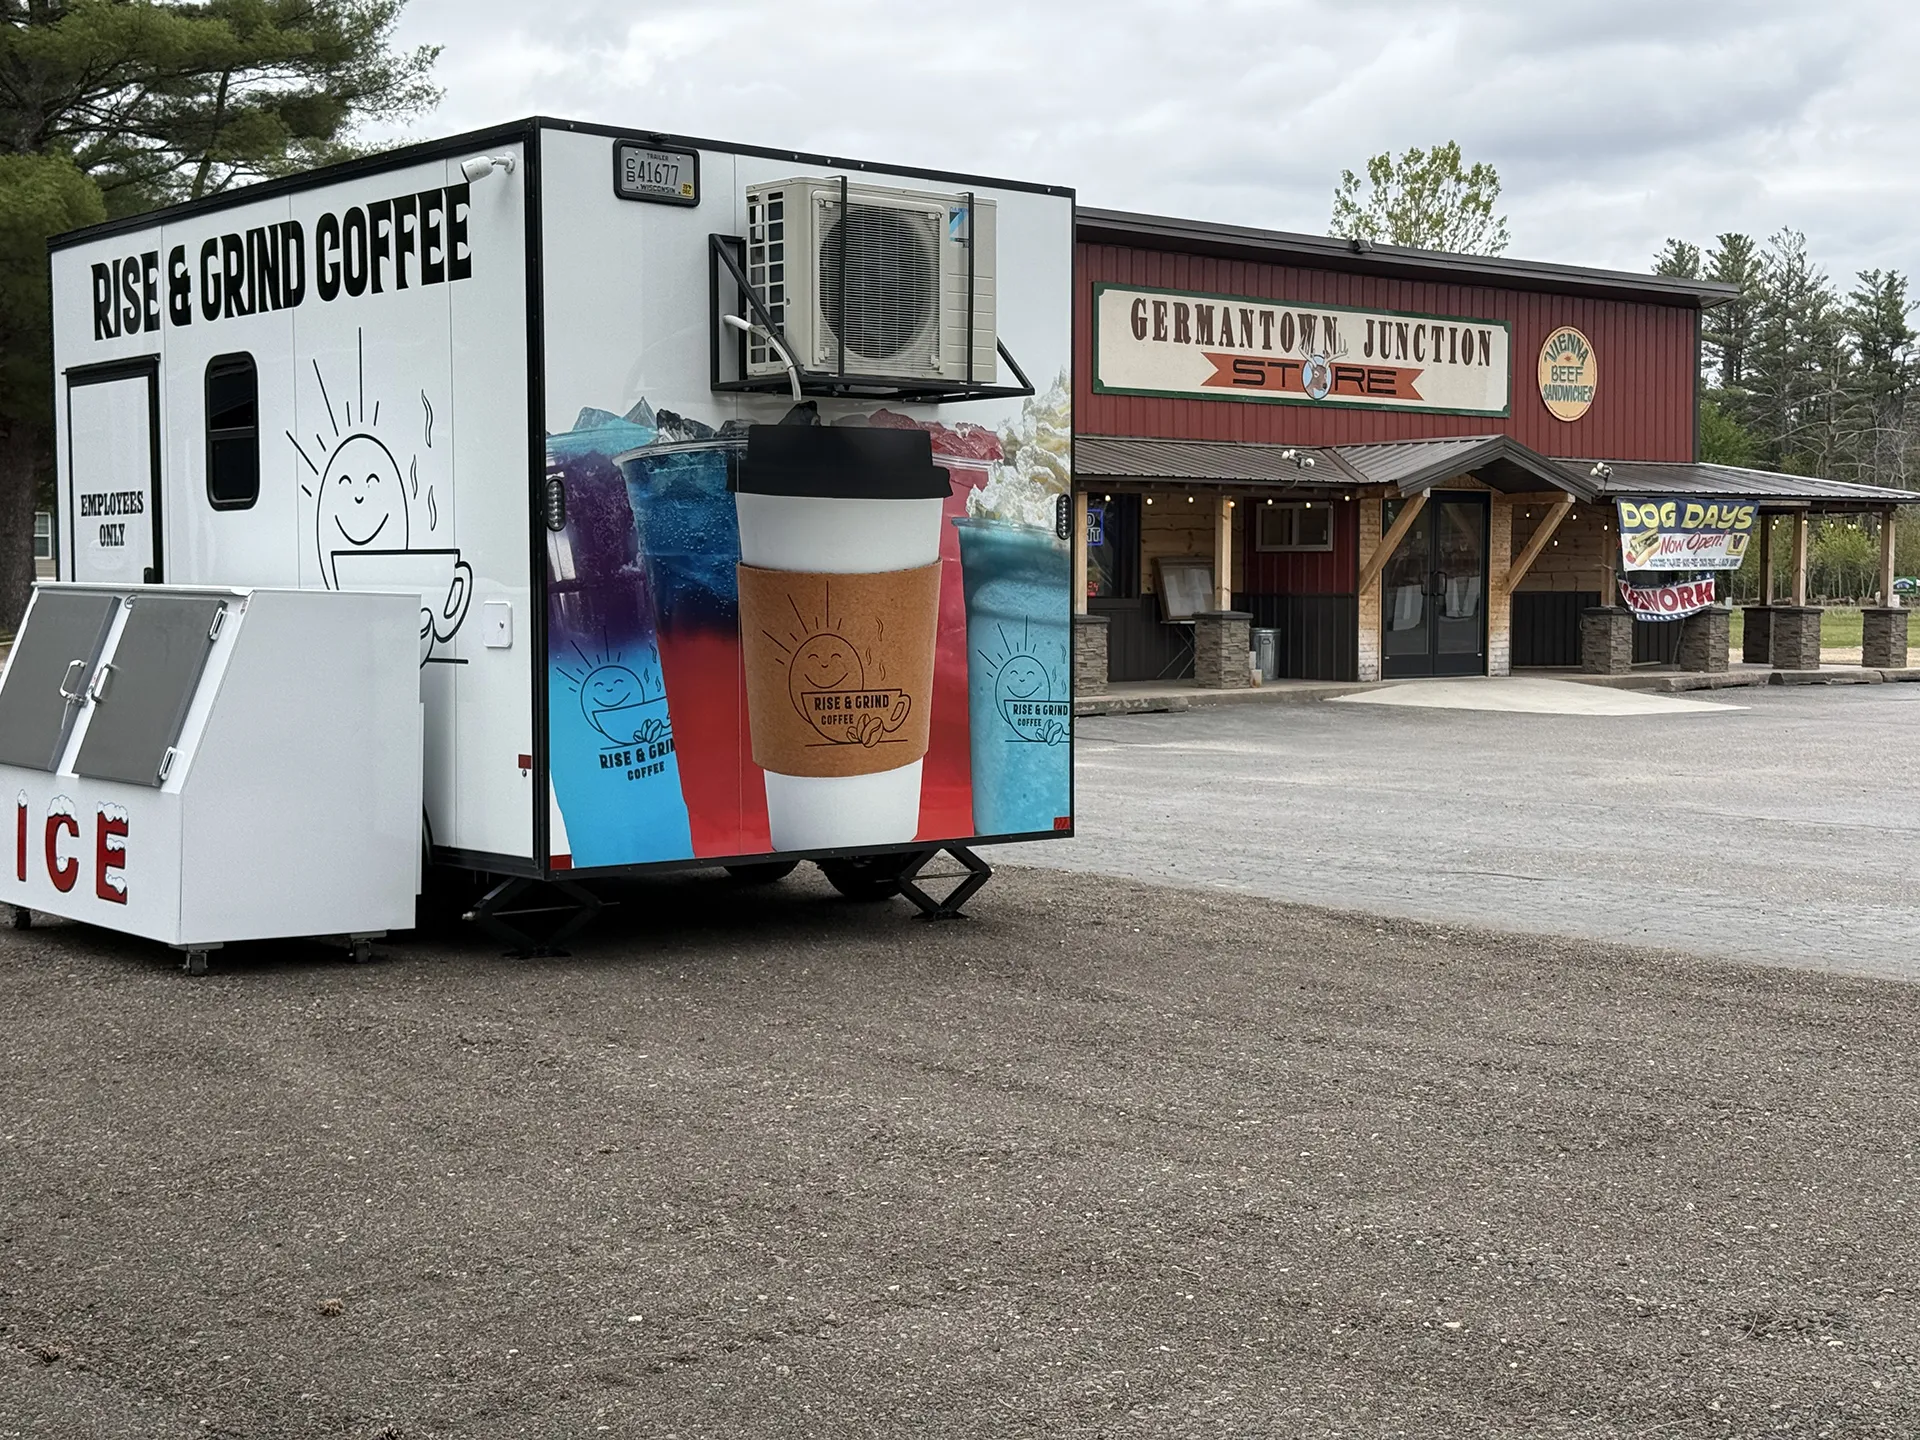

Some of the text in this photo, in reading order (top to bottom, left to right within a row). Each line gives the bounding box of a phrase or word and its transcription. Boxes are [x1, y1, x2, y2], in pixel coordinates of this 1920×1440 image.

[646, 152, 669, 161] TRAILER
[637, 160, 679, 186] 41677
[640, 184, 676, 194] WISCONSIN
[91, 182, 472, 341] RISE & GRIND COFFEE
[1130, 297, 1492, 367] GERMANTOWN JUNCTION
[1544, 333, 1590, 366] VIENNA
[1551, 364, 1584, 383] BEEF
[1543, 383, 1593, 403] SANDWICHES
[81, 490, 144, 517] EMPLOYEES
[1620, 502, 1755, 530] DOG DAYS
[99, 523, 125, 547] ONLY
[813, 694, 889, 711] RISE & GRIND
[1013, 704, 1068, 716] RISE & GRIND
[821, 714, 854, 725] COFFEE
[1017, 718, 1042, 727] COFFEE
[599, 738, 676, 769] RISE & GRIN
[627, 761, 665, 781] COFFEE
[17, 789, 129, 905] ICE
